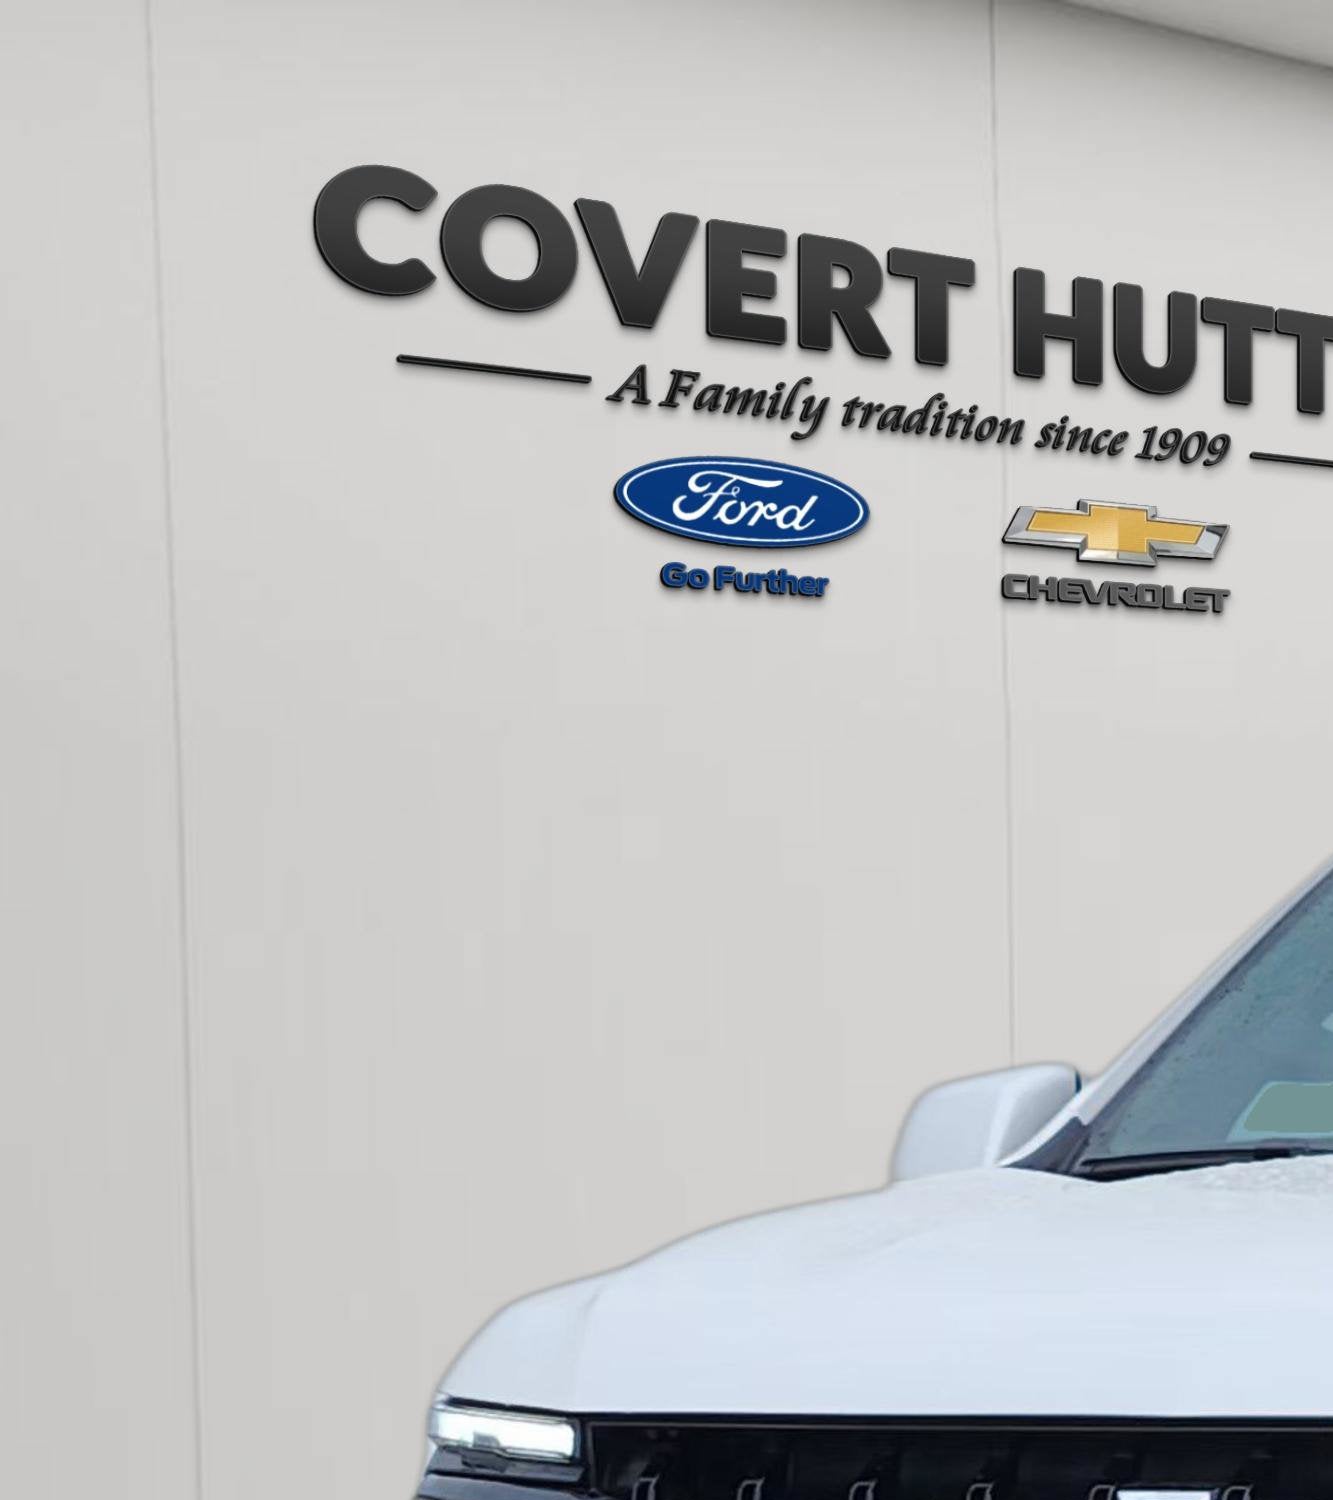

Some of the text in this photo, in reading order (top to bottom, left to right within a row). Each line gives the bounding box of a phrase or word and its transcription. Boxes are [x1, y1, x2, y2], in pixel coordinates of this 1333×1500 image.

[313, 165, 975, 368] COVERT
[606, 364, 1232, 467] A Family tradition since 1909
[672, 469, 818, 533] Ford
[660, 562, 830, 598] Go Further
[1001, 573, 1231, 614] CHEVROLET
